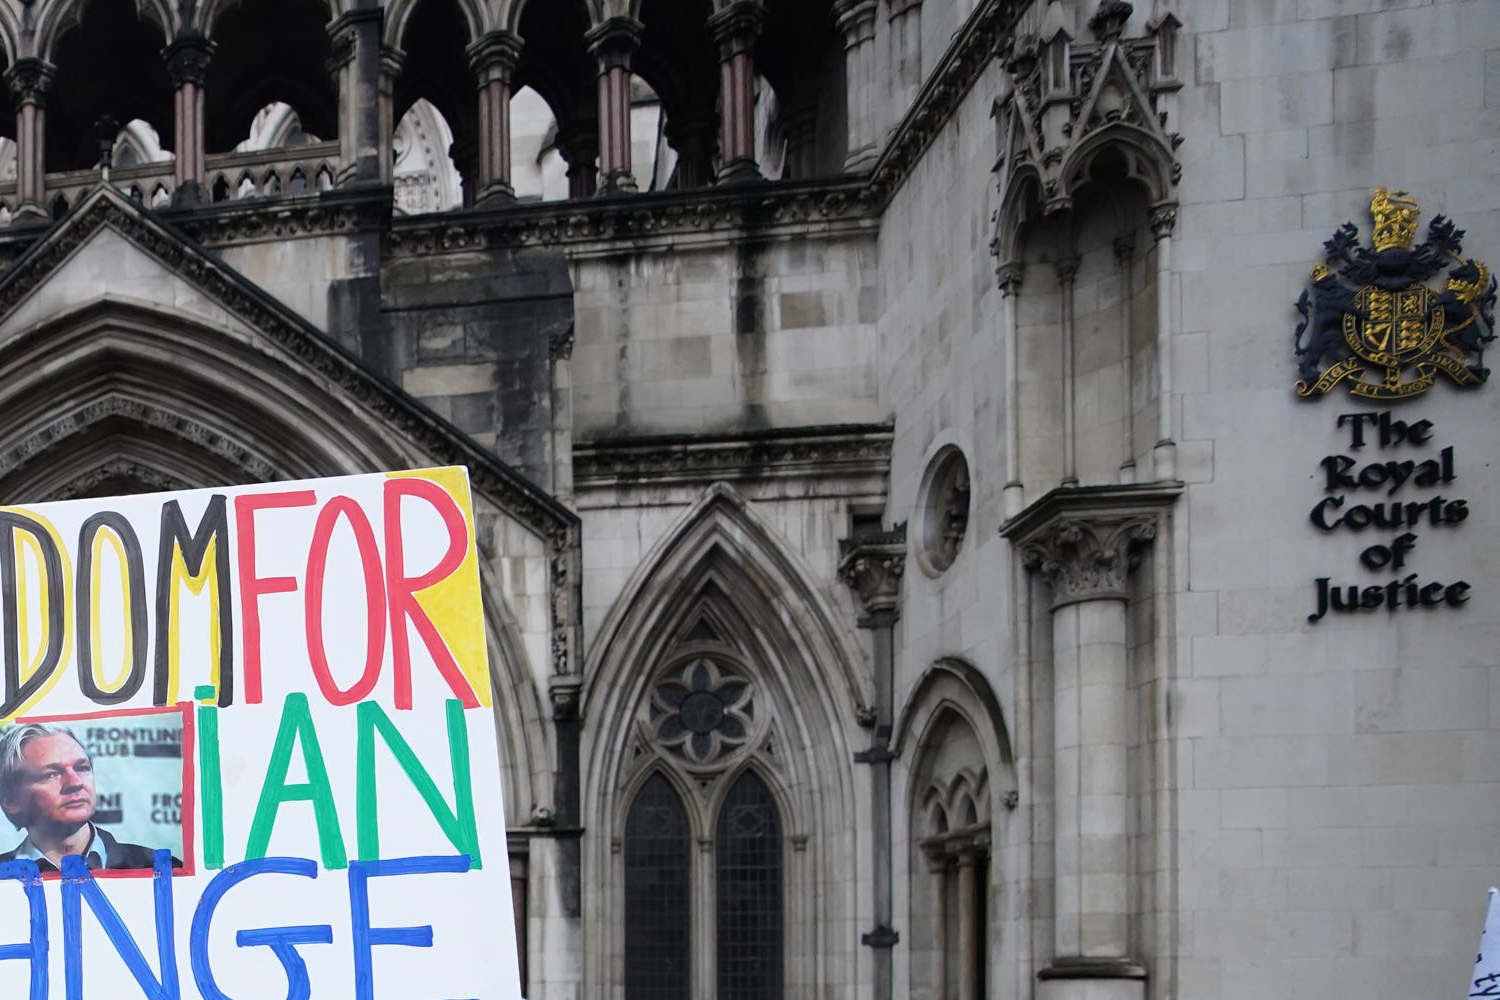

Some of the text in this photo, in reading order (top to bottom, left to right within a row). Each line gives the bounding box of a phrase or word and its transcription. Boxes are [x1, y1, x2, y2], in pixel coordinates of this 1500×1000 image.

[1337, 410, 1435, 450] The
[1320, 446, 1456, 497] Royal
[1309, 494, 1470, 532] Courts
[1360, 531, 1418, 573] of
[234, 477, 481, 710] FOR
[1307, 572, 1472, 624] Justice
